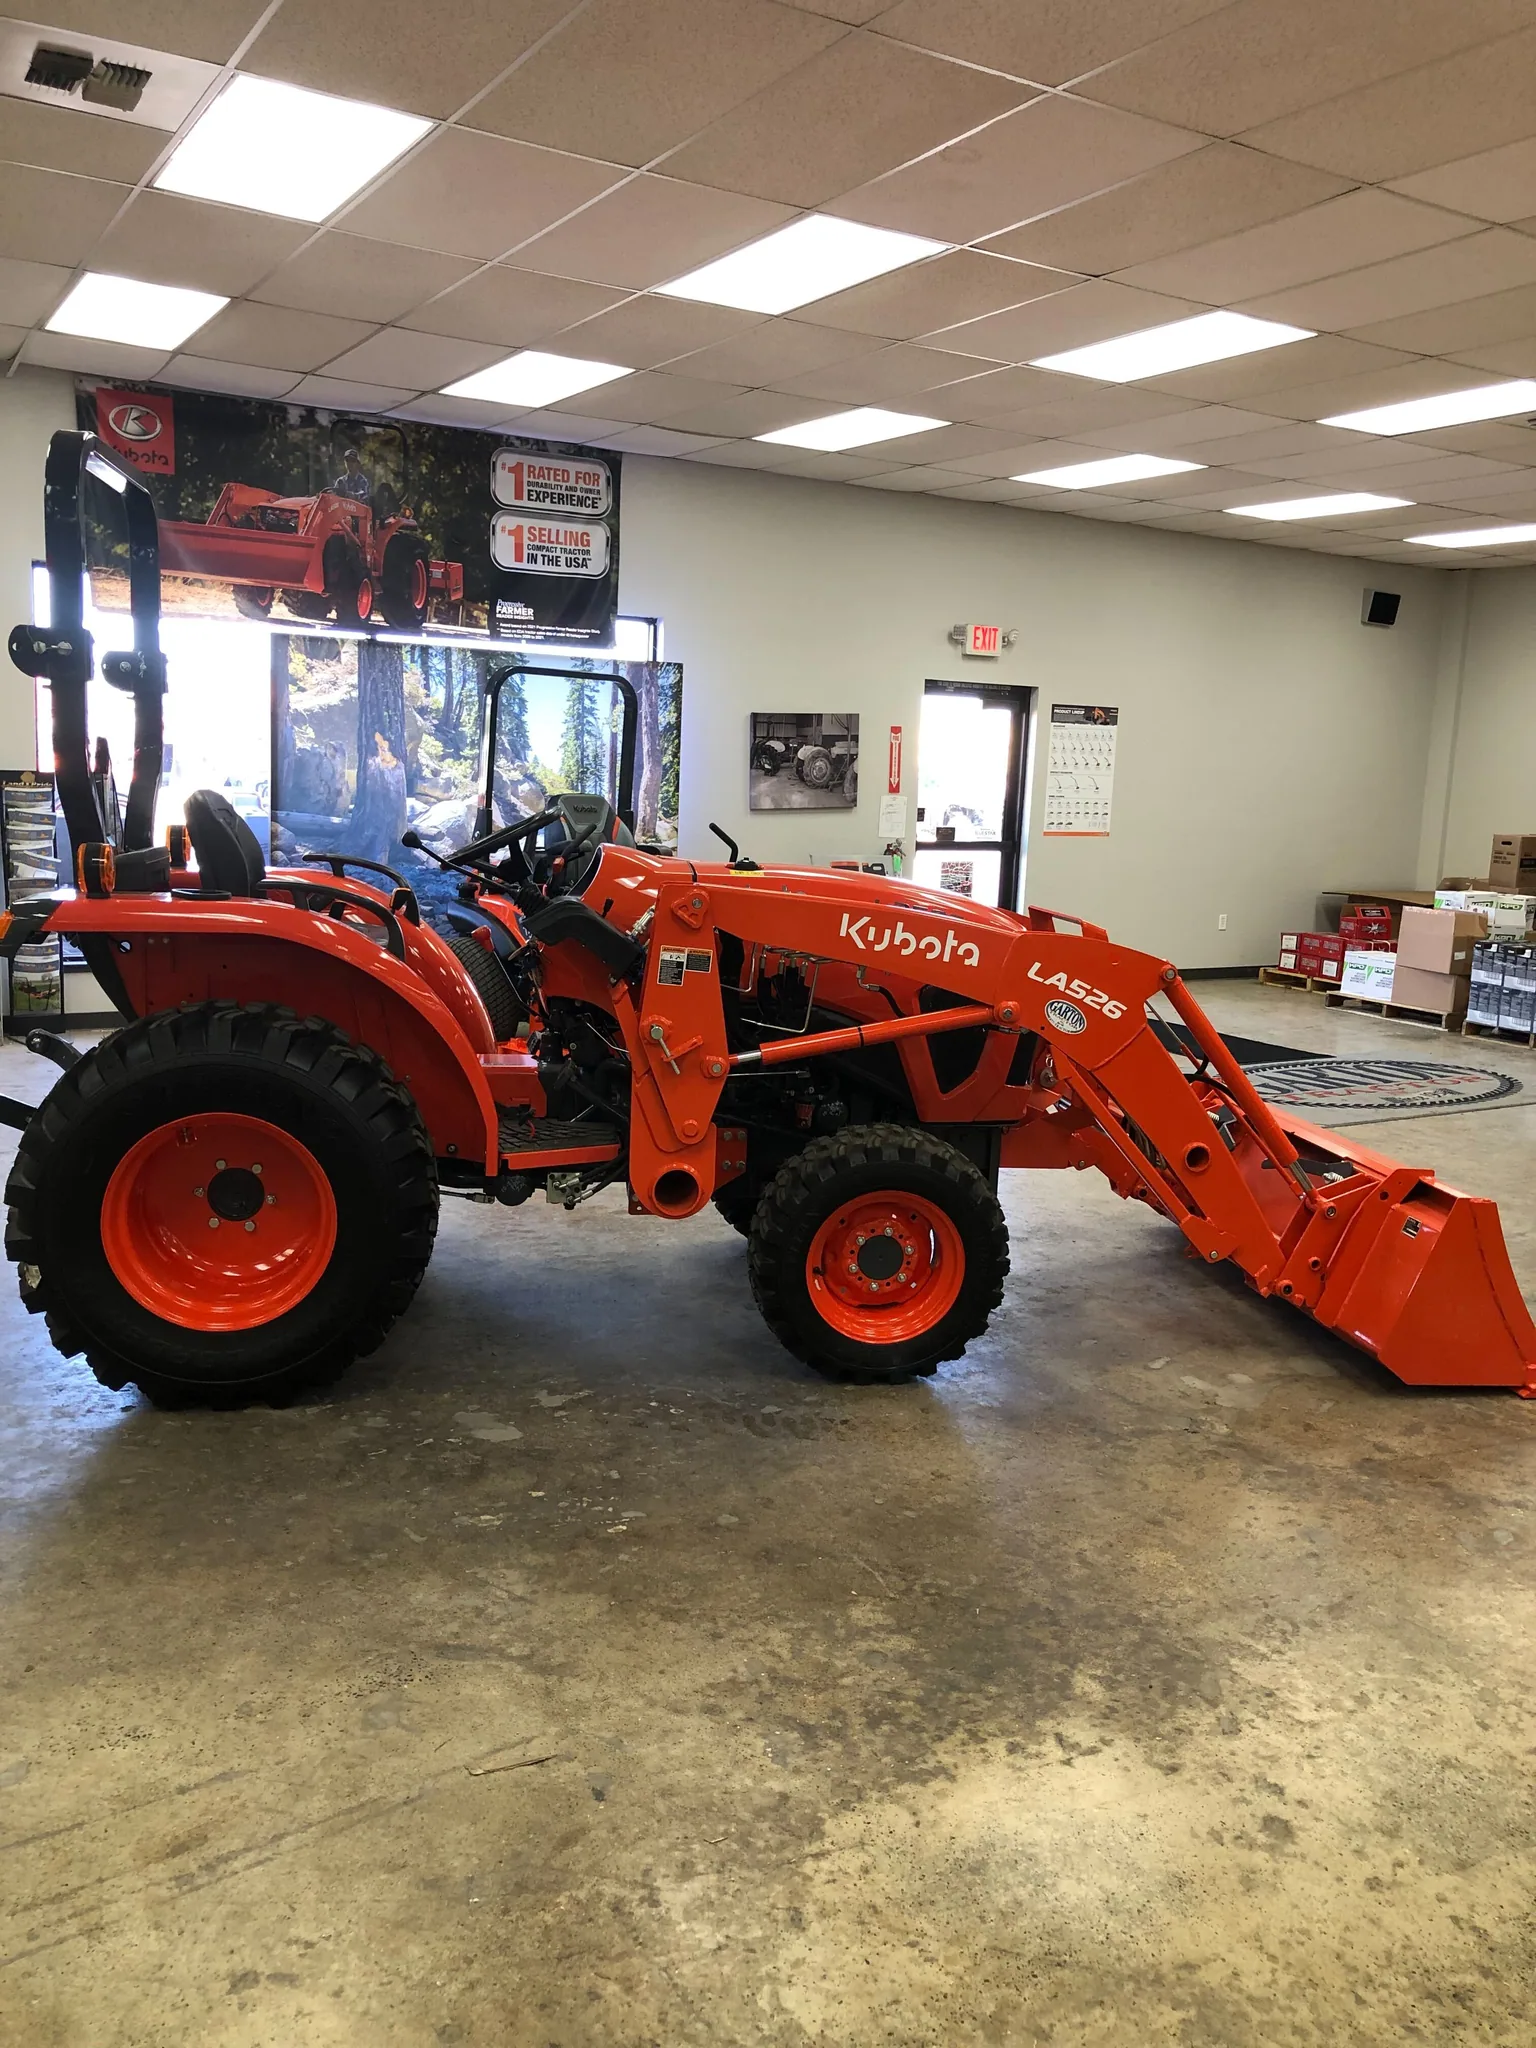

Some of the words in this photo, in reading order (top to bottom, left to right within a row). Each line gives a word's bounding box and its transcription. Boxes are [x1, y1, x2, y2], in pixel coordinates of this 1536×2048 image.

[113, 445, 169, 466] ubota
[527, 465, 570, 483] RATED
[575, 471, 600, 487] FOR
[527, 481, 562, 491] DURABILITY
[565, 485, 577, 493] AND
[580, 487, 600, 496] OWNER
[527, 526, 590, 548] SELLING
[527, 544, 558, 554] COMPACT
[560, 547, 591, 556] TRACTOR
[527, 553, 538, 565] IN
[540, 554, 561, 567] THE
[496, 606, 534, 616] FARMER
[973, 626, 998, 651] EXIT
[572, 804, 598, 813] Kubota
[839, 912, 980, 967] Kubota
[1027, 961, 1128, 1020] LA526
[1050, 1000, 1083, 1029] GARTON
